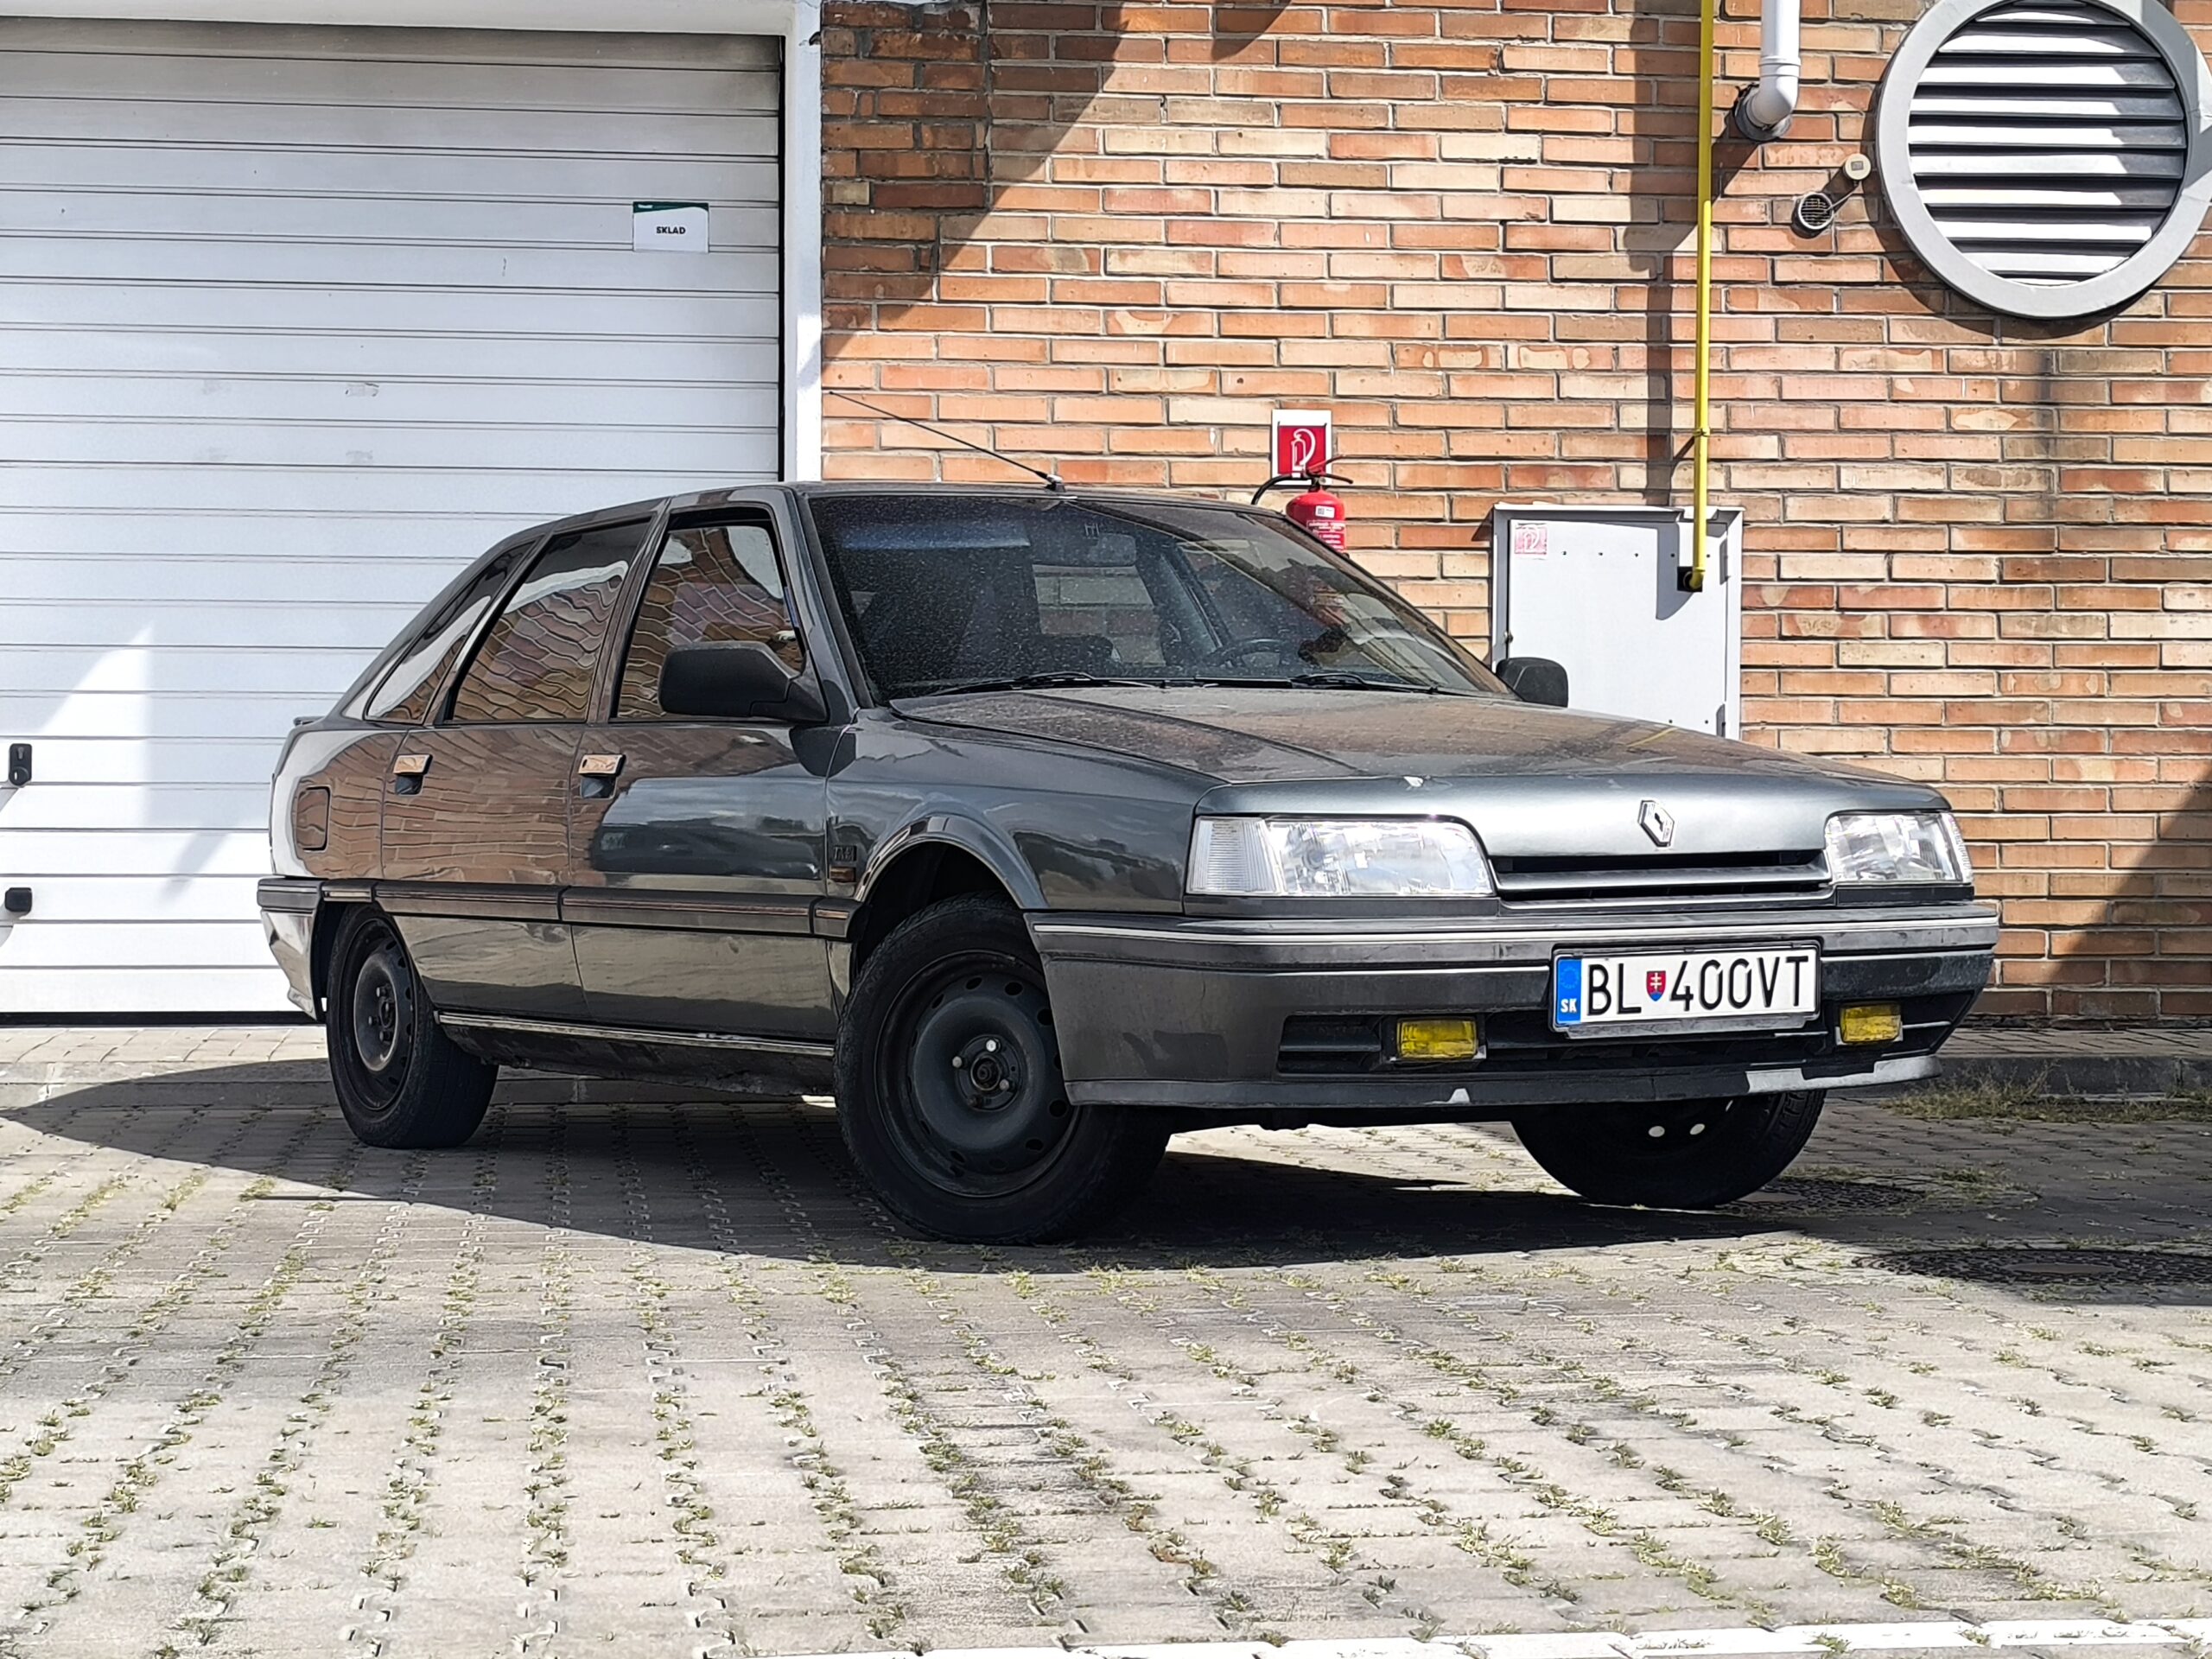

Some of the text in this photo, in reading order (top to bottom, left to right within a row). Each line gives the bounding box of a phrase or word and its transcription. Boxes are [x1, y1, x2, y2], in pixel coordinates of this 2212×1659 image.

[656, 226, 686, 234] SKLAD
[1586, 955, 1809, 1016] BL 400VT
[1560, 998, 1577, 1013] SK
